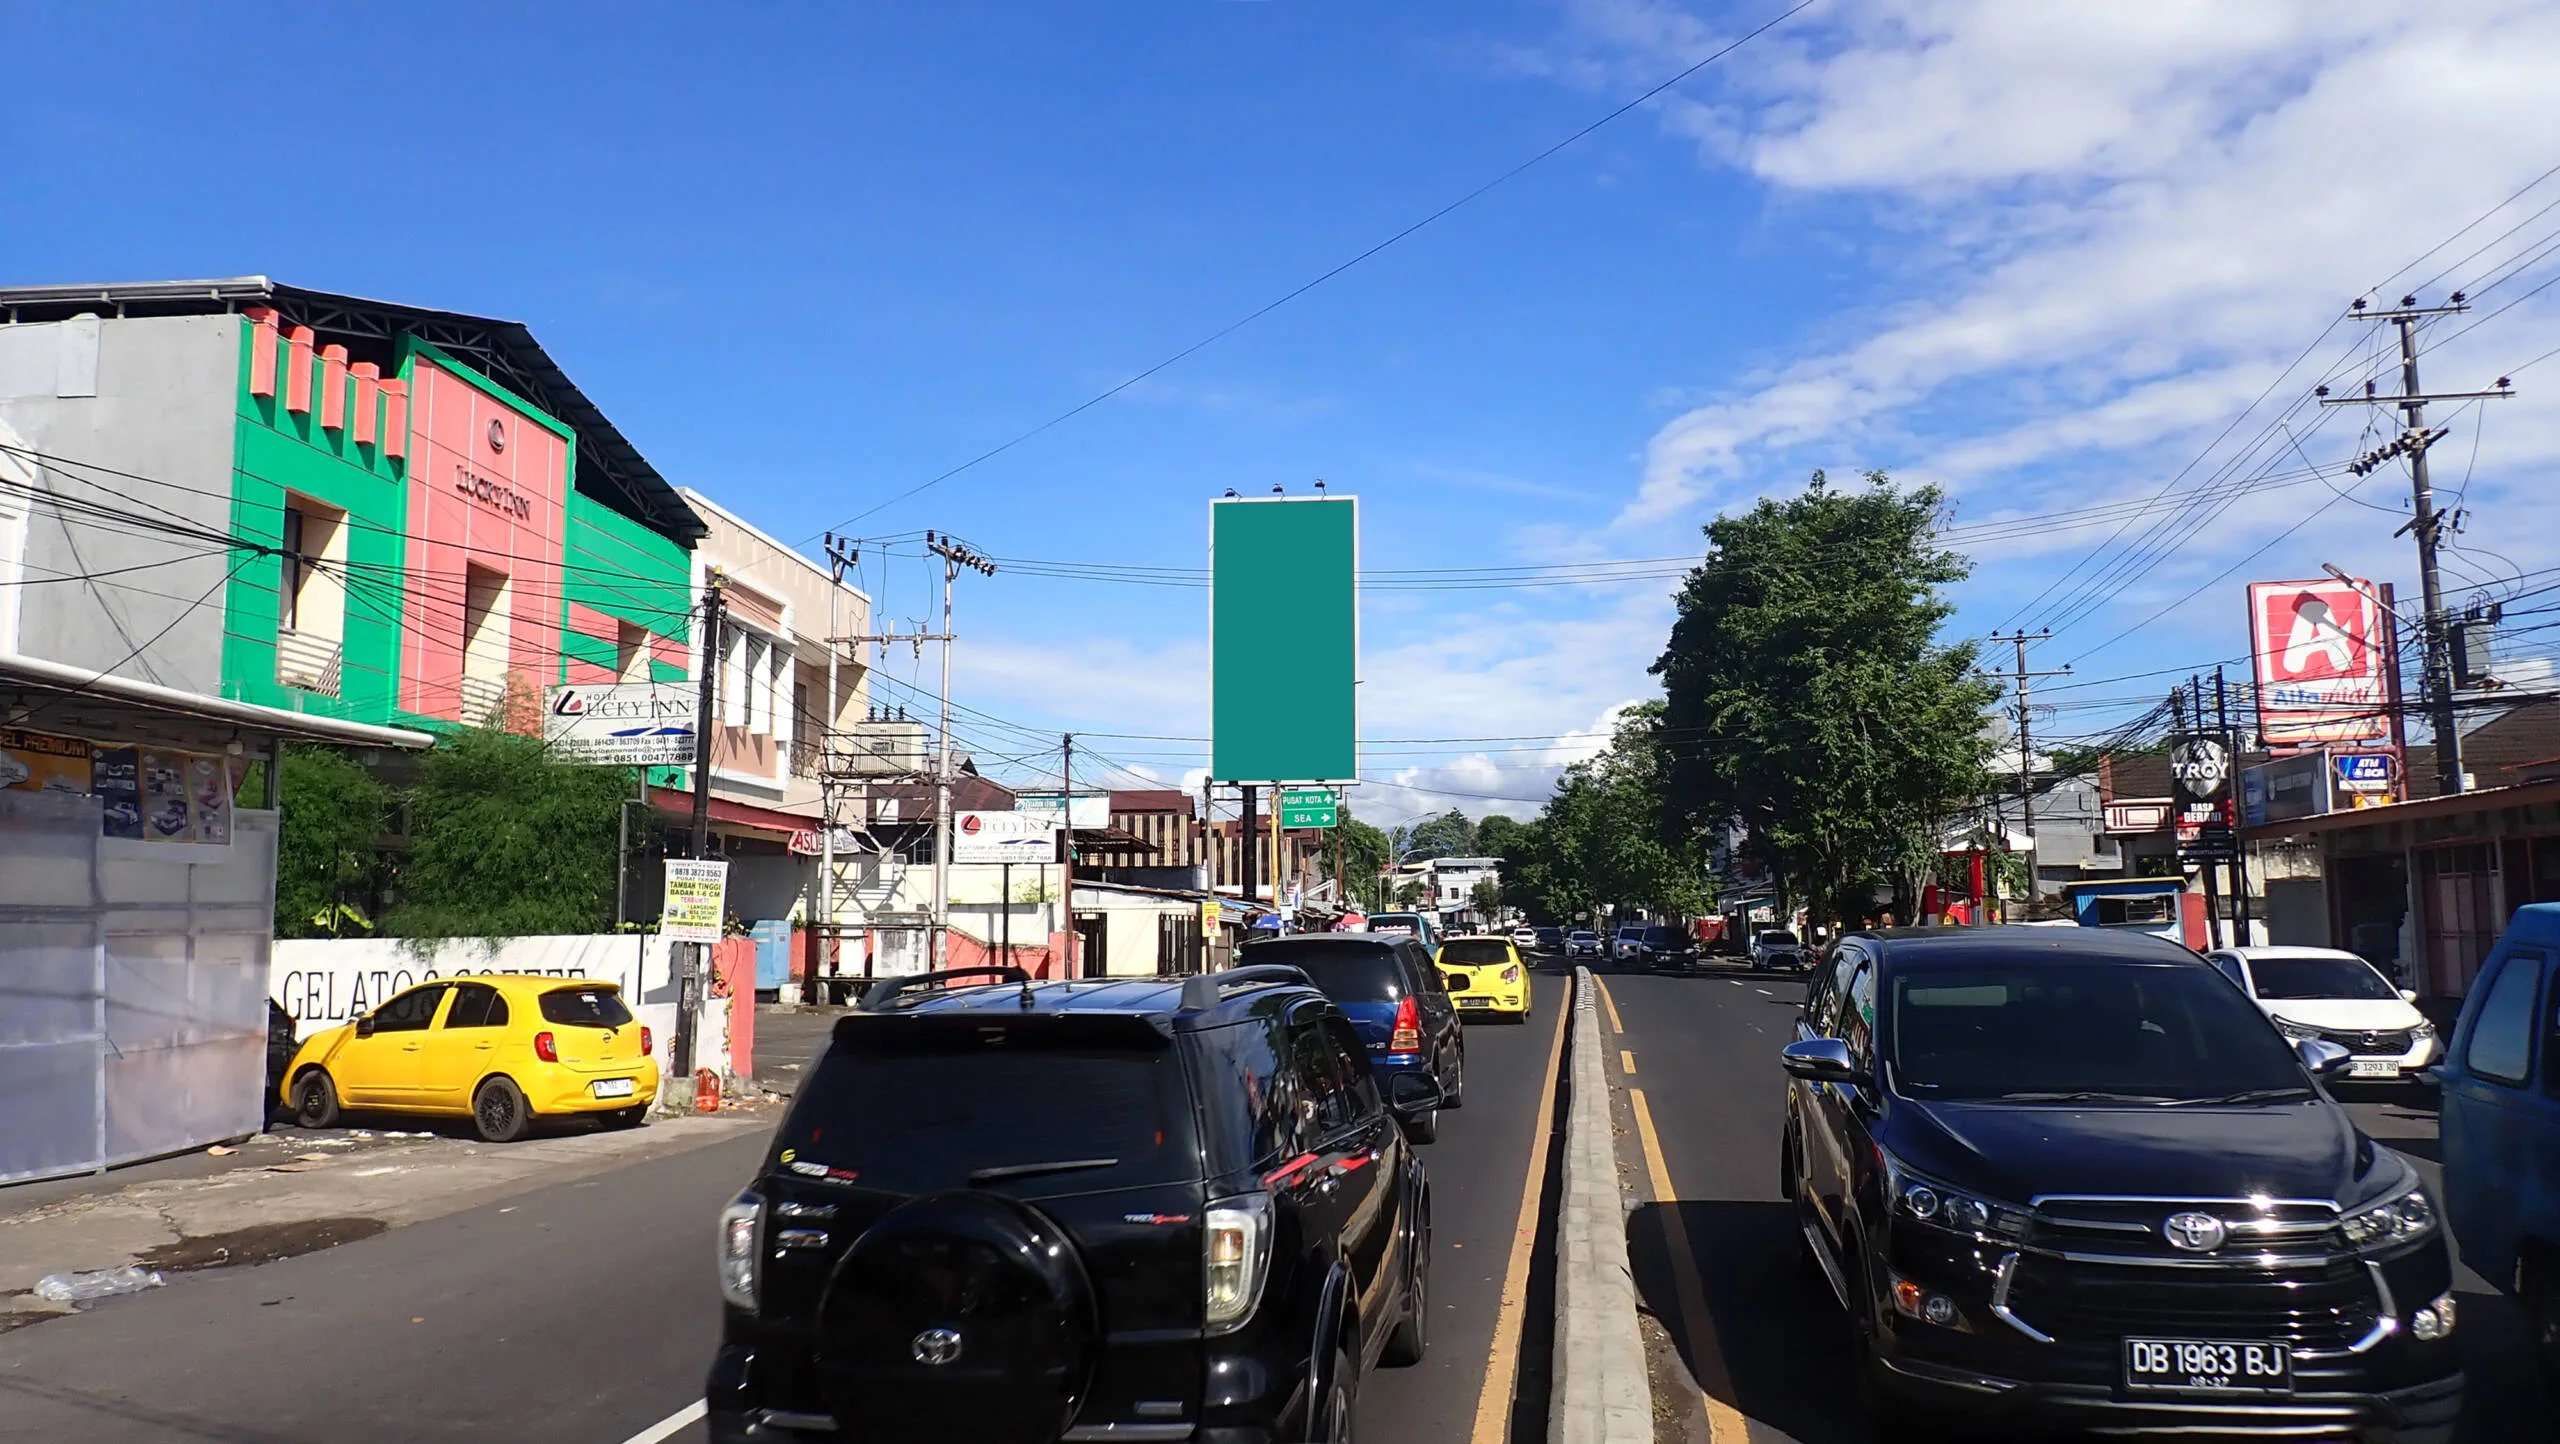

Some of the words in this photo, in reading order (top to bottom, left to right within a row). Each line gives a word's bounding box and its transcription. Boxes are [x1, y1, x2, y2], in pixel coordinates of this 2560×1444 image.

[553, 690, 642, 717] LUCKY
[650, 692, 690, 718] INN
[613, 754, 638, 762] 0851
[641, 753, 666, 762] 0047
[1283, 796, 1302, 804] PUSAT
[1305, 796, 1322, 804] KOTA
[1294, 814, 1312, 823] SEA
[698, 882, 721, 890] TINGGI
[670, 889, 694, 897] BADAN
[2132, 1342, 2170, 1374] DB
[2173, 1343, 2238, 1375] 1963
[2244, 1346, 2283, 1376] BJ
